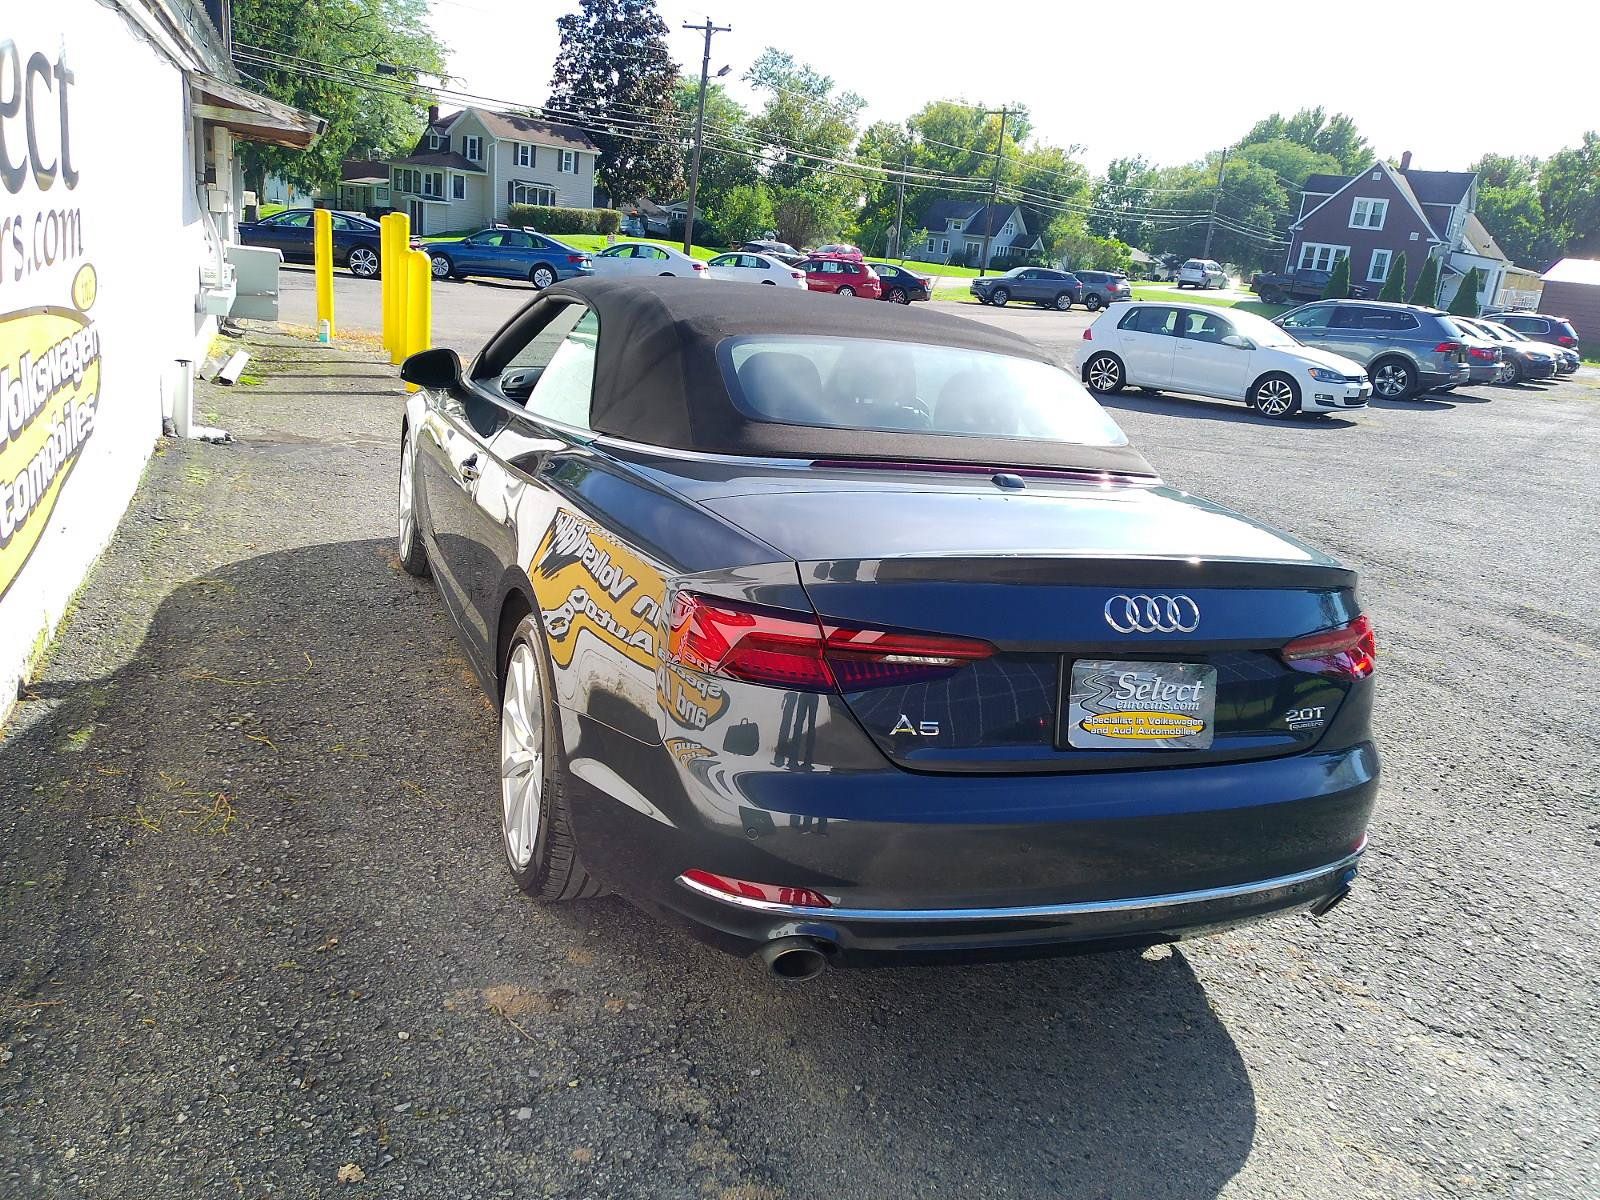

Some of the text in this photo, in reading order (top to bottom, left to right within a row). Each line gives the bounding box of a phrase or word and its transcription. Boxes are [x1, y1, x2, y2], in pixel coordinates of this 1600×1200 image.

[1115, 671, 1204, 701] Select
[889, 713, 940, 736] A5
[1084, 715, 1204, 727] Specialist in Volkswagen
[1090, 726, 1197, 736] and Audi Automobiles
